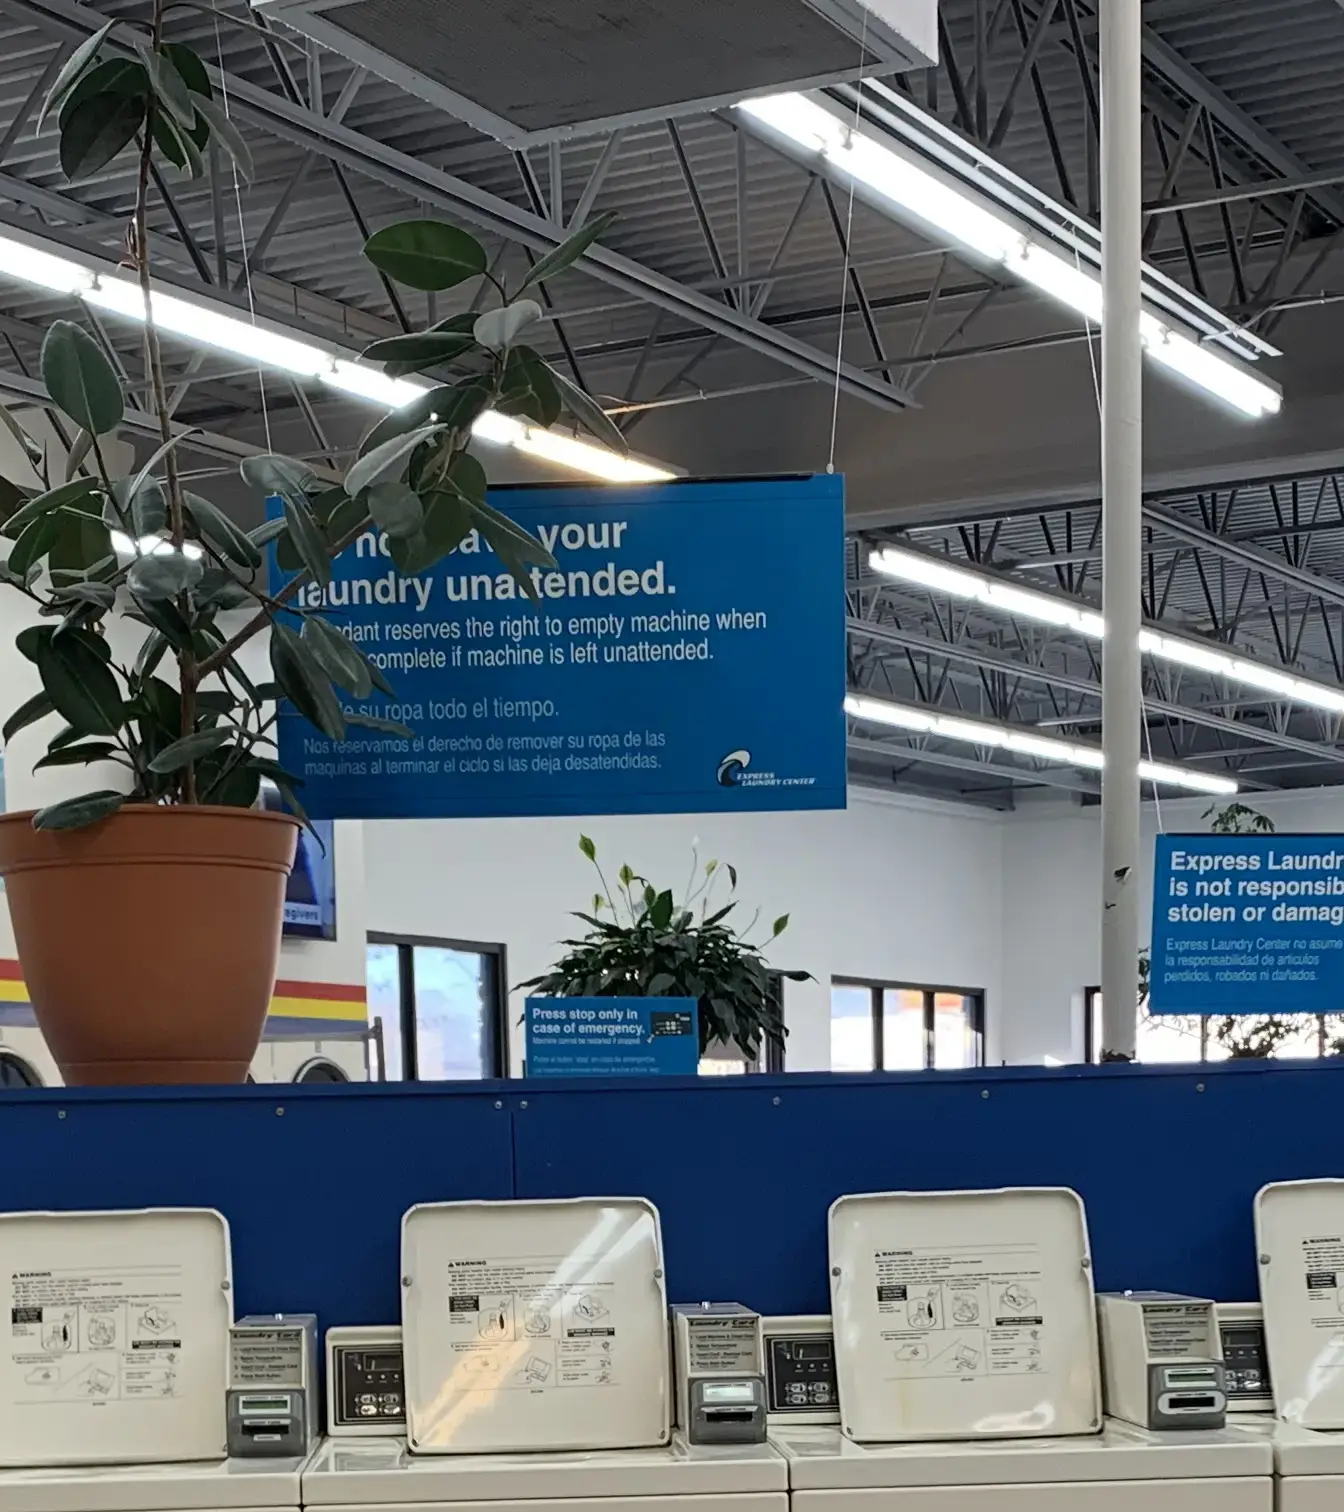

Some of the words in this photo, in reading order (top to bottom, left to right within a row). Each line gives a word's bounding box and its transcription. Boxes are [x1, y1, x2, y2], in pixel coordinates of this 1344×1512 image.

[537, 520, 627, 553] your
[298, 570, 433, 612] laundry
[447, 561, 676, 601] unatended.
[385, 620, 460, 640] reserves
[465, 616, 494, 638] the
[500, 615, 539, 643] right
[545, 617, 562, 637] to
[568, 613, 624, 639] empty
[631, 609, 710, 633] machine
[716, 607, 766, 630] when
[367, 647, 446, 674] complete
[451, 645, 462, 667] if
[467, 643, 543, 667] machine
[549, 644, 564, 665] is
[570, 641, 598, 664] left
[604, 638, 714, 662] unattended.
[359, 703, 379, 719] su
[385, 702, 424, 725] ropa
[429, 698, 467, 720] todo
[473, 697, 488, 718] el
[493, 697, 560, 722] tiempo.
[304, 738, 330, 754] Nos
[333, 738, 409, 754] reservamos
[413, 735, 424, 752] el
[428, 734, 482, 752] derecho
[485, 734, 504, 751] de
[507, 735, 564, 750] remover
[567, 733, 585, 749] su
[588, 733, 620, 753] ropa
[623, 730, 642, 747] de
[645, 729, 666, 747] las
[370, 758, 382, 775] al
[386, 758, 440, 775] terminar
[443, 757, 455, 774] el
[459, 756, 490, 773] ciclo
[493, 756, 505, 773] si
[508, 755, 529, 772] las
[532, 754, 561, 775] deja
[564, 753, 662, 772] desatendidas.
[737, 772, 775, 780] EXPRESS
[741, 779, 782, 787] LAUNDRY
[782, 777, 816, 786] CENTER
[1171, 850, 1261, 875] Express
[1169, 876, 1188, 897] is
[1195, 878, 1232, 897] not
[1167, 903, 1236, 922] stolen
[1242, 906, 1266, 923] or
[1166, 937, 1208, 952] Express
[1211, 937, 1254, 953] Laundry
[1256, 937, 1291, 950] Center
[1293, 939, 1306, 949] no
[1308, 939, 1344, 950] asume
[1165, 954, 1175, 966] la
[1177, 953, 1259, 968] responsabilidad
[1261, 954, 1275, 966] de
[1215, 970, 1257, 982] robados
[1260, 970, 1269, 981] ni
[532, 1008, 567, 1020] Press
[569, 1009, 597, 1022] stop
[599, 1008, 625, 1022] only
[627, 1008, 638, 1020] in
[532, 1023, 561, 1034] case
[563, 1022, 576, 1034] of
[578, 1023, 646, 1037] emergency.
